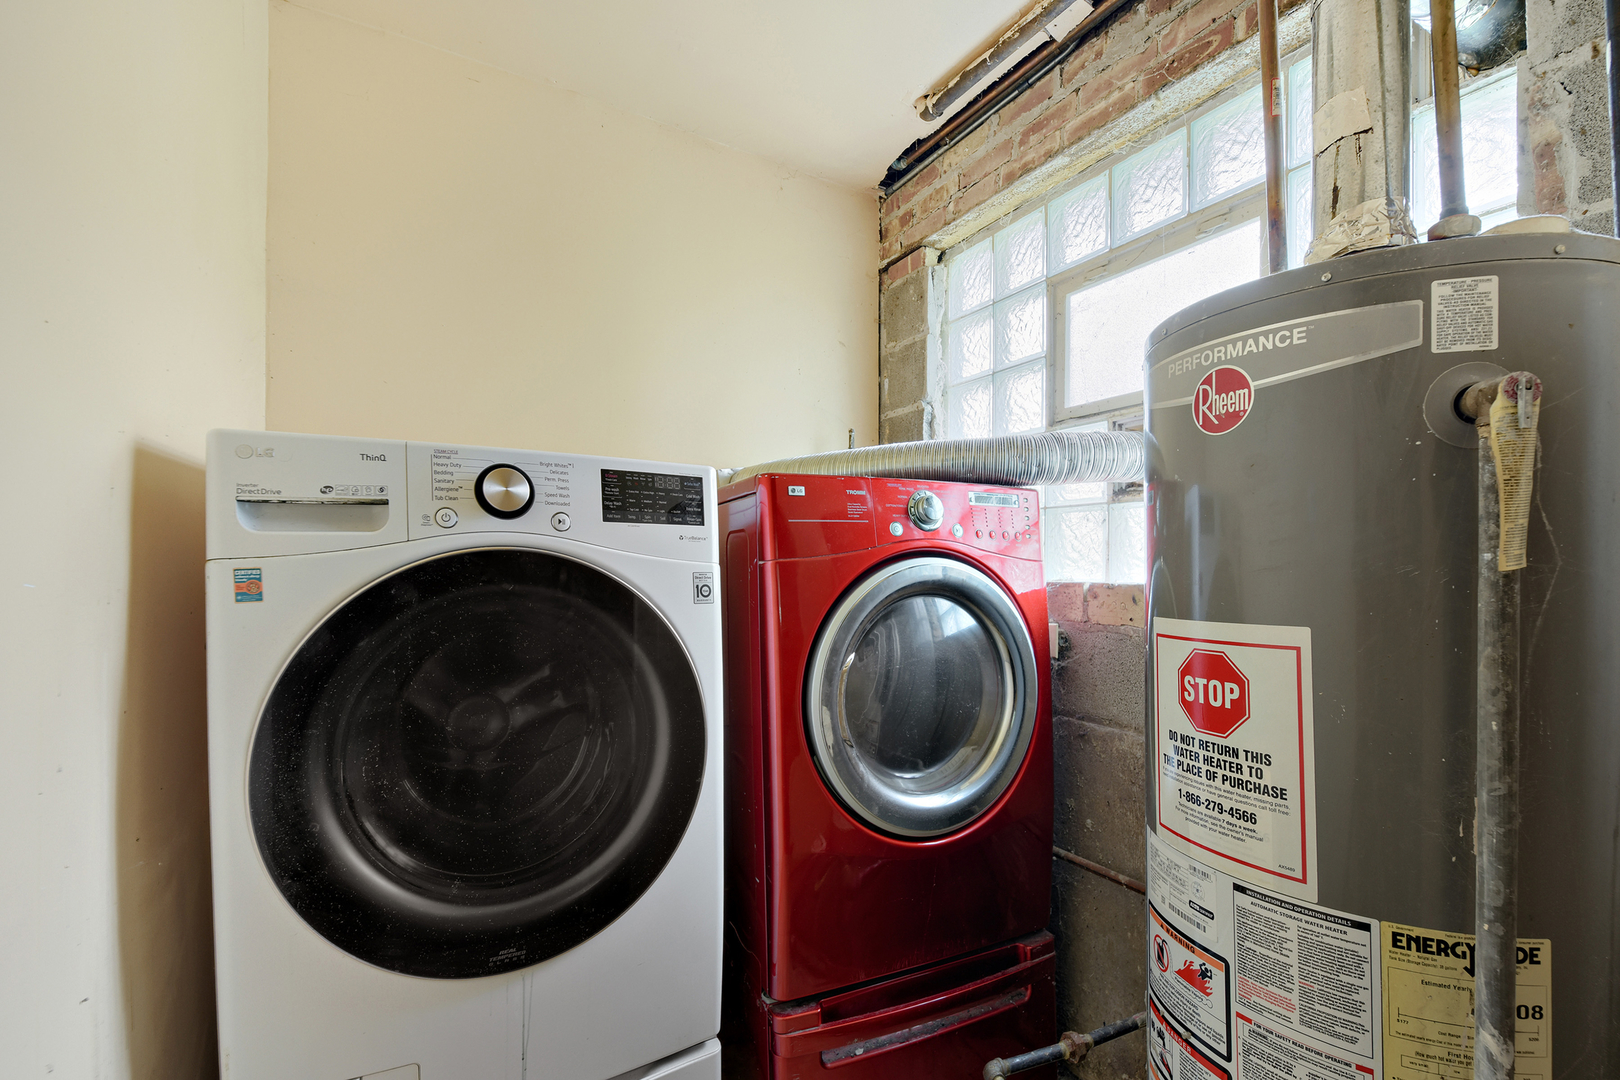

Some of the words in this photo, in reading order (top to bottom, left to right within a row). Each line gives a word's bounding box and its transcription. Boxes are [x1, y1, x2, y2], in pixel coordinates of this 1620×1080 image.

[1200, 371, 1249, 425] Rheem
[360, 453, 387, 462] ThinQ
[696, 584, 711, 598] 10
[1184, 675, 1240, 709] STOP
[1169, 729, 1178, 742] DO
[1180, 733, 1196, 748] NOT
[1199, 739, 1239, 759] RETURN
[1243, 750, 1272, 766] THIS
[1173, 744, 1200, 763] WATER
[1203, 754, 1243, 775] HEATER
[1247, 765, 1263, 780] TO
[1163, 753, 1175, 768] THE
[1177, 759, 1202, 778] PLACE
[1206, 769, 1218, 782] OF
[1222, 774, 1287, 801] PURCHASE
[1178, 788, 1257, 825] 1-866-279-4566
[1217, 793, 1233, 801] general
[1234, 798, 1257, 808] questions
[1236, 792, 1252, 801] heater,
[1254, 797, 1273, 806] missing
[1185, 817, 1199, 826] provided
[1231, 834, 1247, 843] heater.
[1204, 813, 1221, 822] available
[1227, 827, 1244, 836] owner's
[1245, 833, 1263, 842] manual
[1246, 890, 1281, 906] INSTALLATION
[1281, 902, 1293, 911] AND
[1294, 906, 1326, 919] OPERATION
[1327, 916, 1352, 926] DETAILS
[1250, 901, 1279, 915] AUTOMATIC
[1280, 911, 1303, 923] STORAGE
[1304, 919, 1324, 929] WATER
[1325, 926, 1348, 935] HEATER
[1166, 926, 1195, 953] WARNING
[1421, 980, 1450, 989] Estimated
[1167, 1027, 1192, 1054] DANGER
[1263, 1027, 1274, 1035] YOUR
[1275, 1032, 1291, 1043] SAFETY
[1292, 1041, 1304, 1050] READ
[1305, 1046, 1323, 1058] BEFORE
[1324, 1054, 1352, 1068] OPERATING
